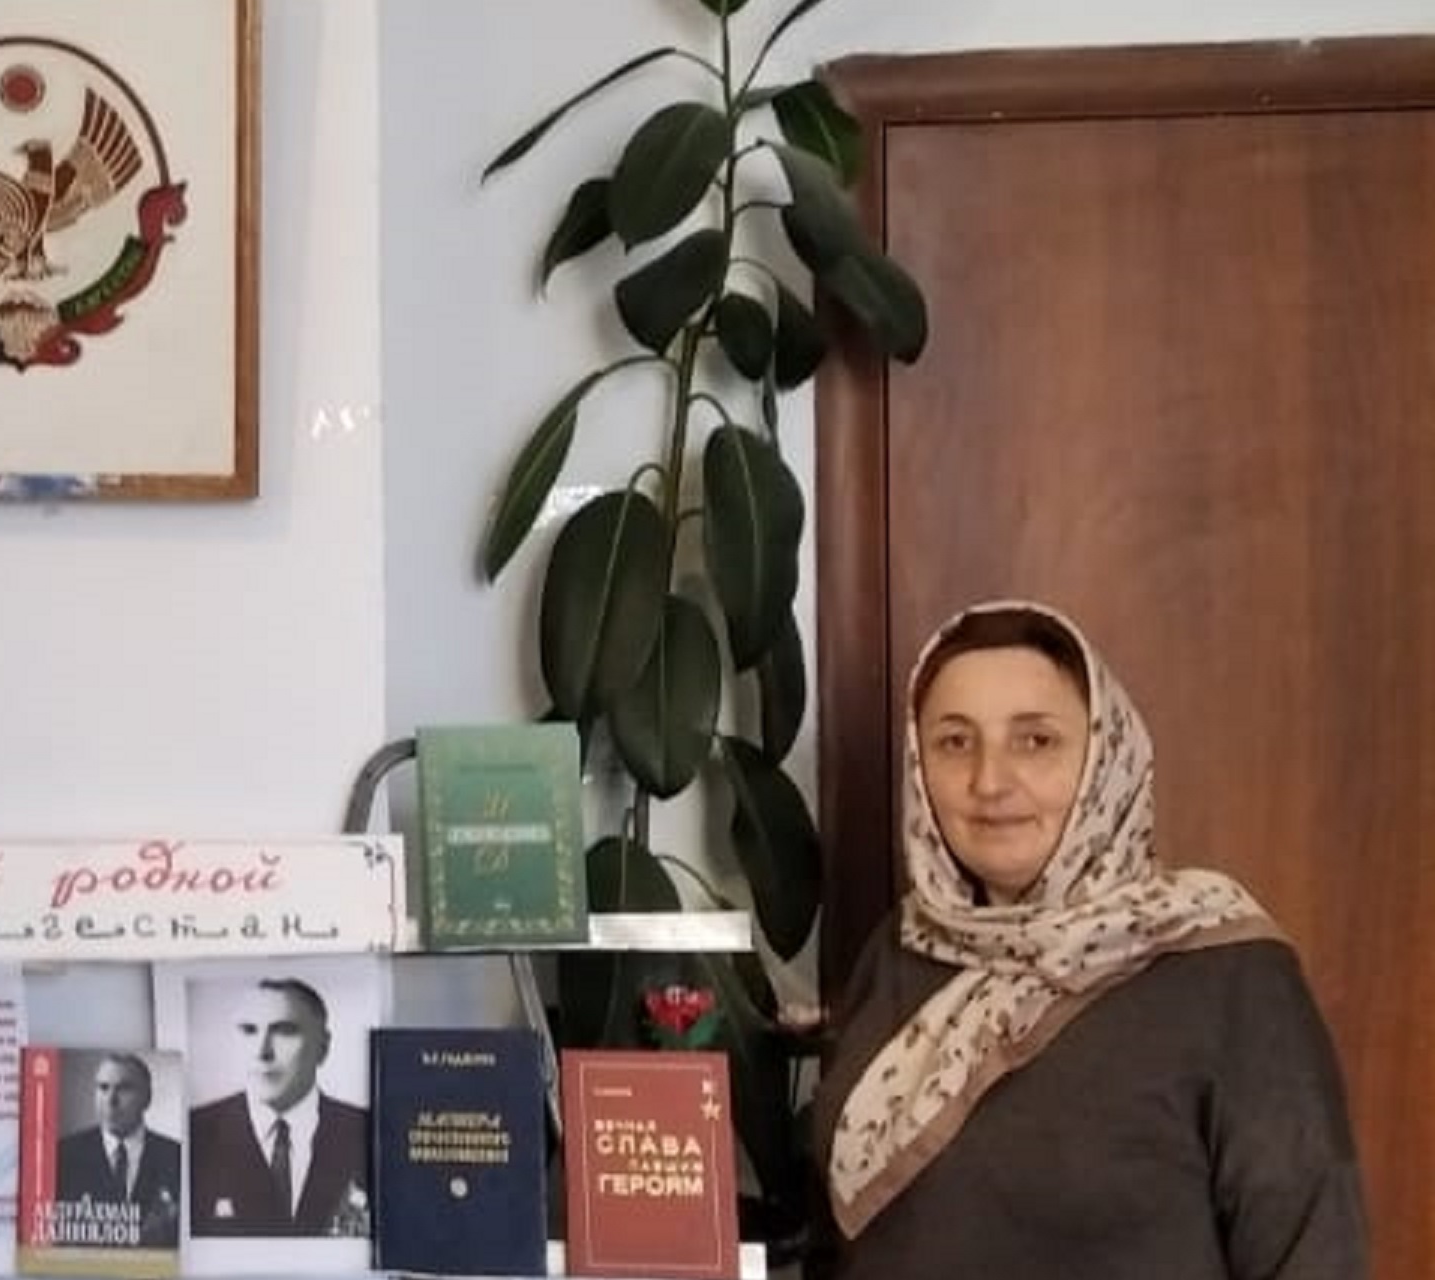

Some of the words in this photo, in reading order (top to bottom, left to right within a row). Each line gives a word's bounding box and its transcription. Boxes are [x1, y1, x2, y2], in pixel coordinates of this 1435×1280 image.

[51, 841, 281, 908] родной
[596, 1133, 702, 1156] СЛАВА
[598, 1173, 704, 1196] ГЕРОЯМ
